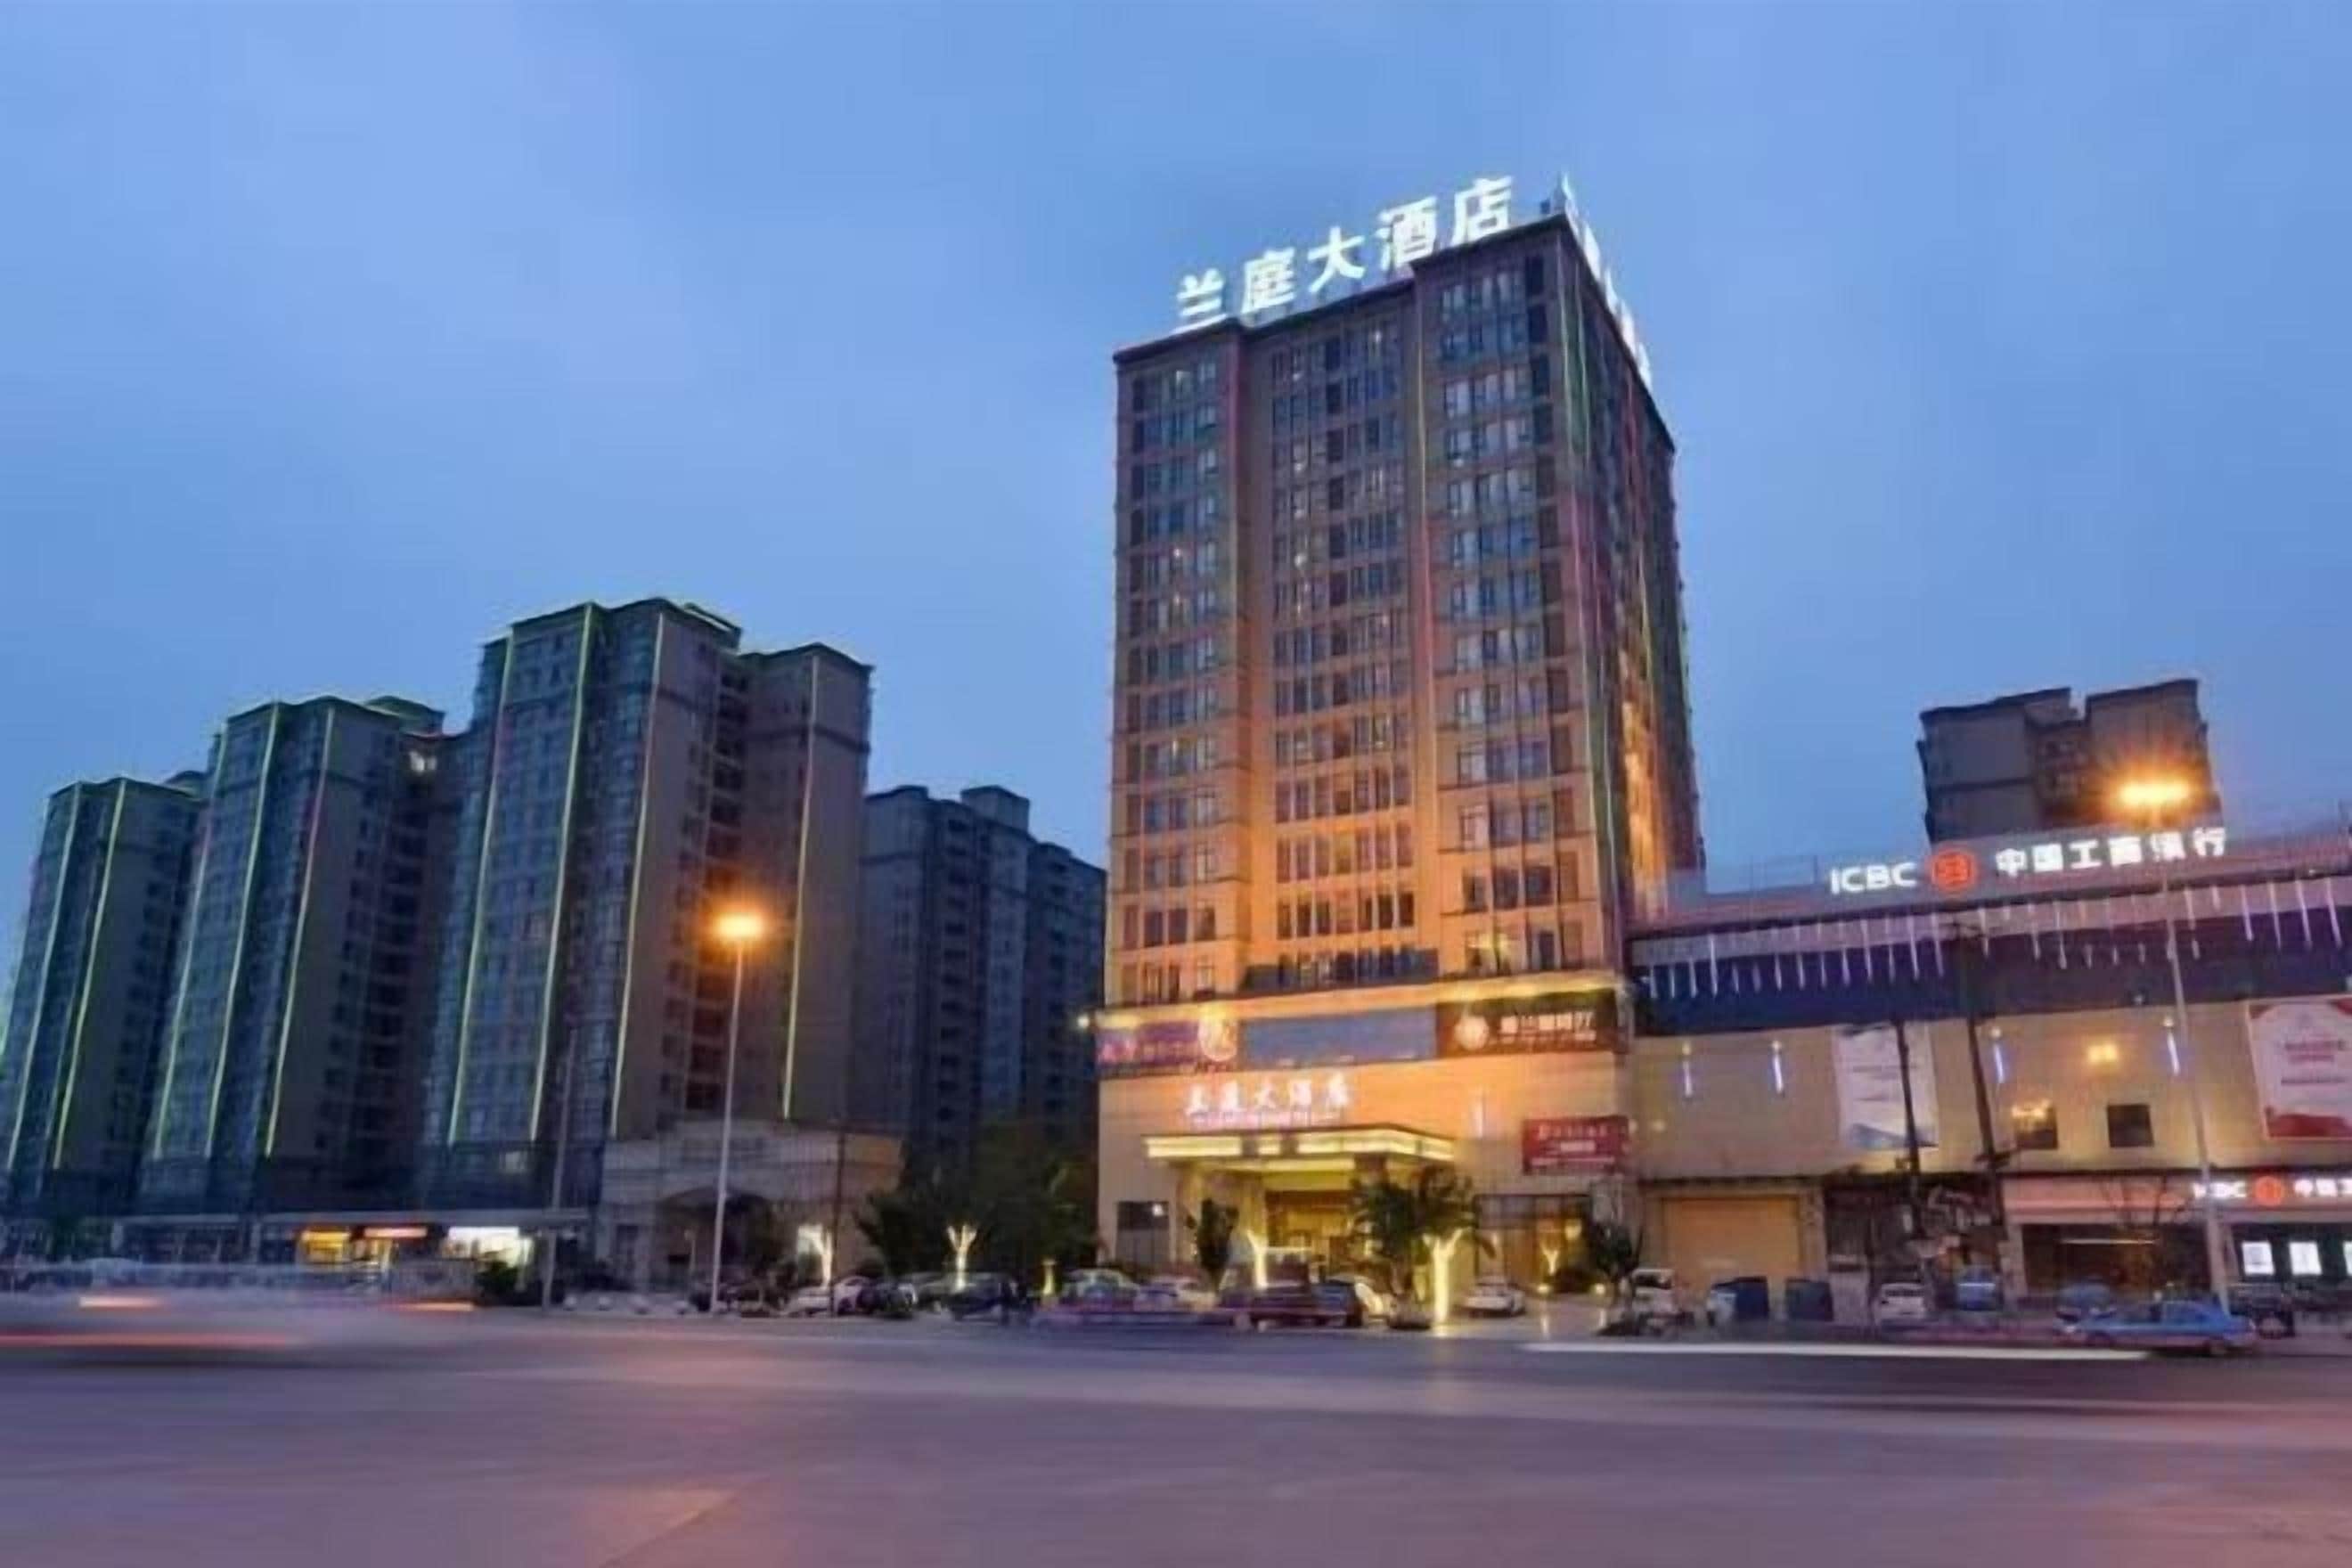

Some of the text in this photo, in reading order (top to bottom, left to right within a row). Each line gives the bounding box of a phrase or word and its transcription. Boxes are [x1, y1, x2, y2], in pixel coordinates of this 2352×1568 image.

[1172, 176, 1514, 335] 兰庭大酒店
[1830, 827, 2225, 894] ICBC 中国工商银行
